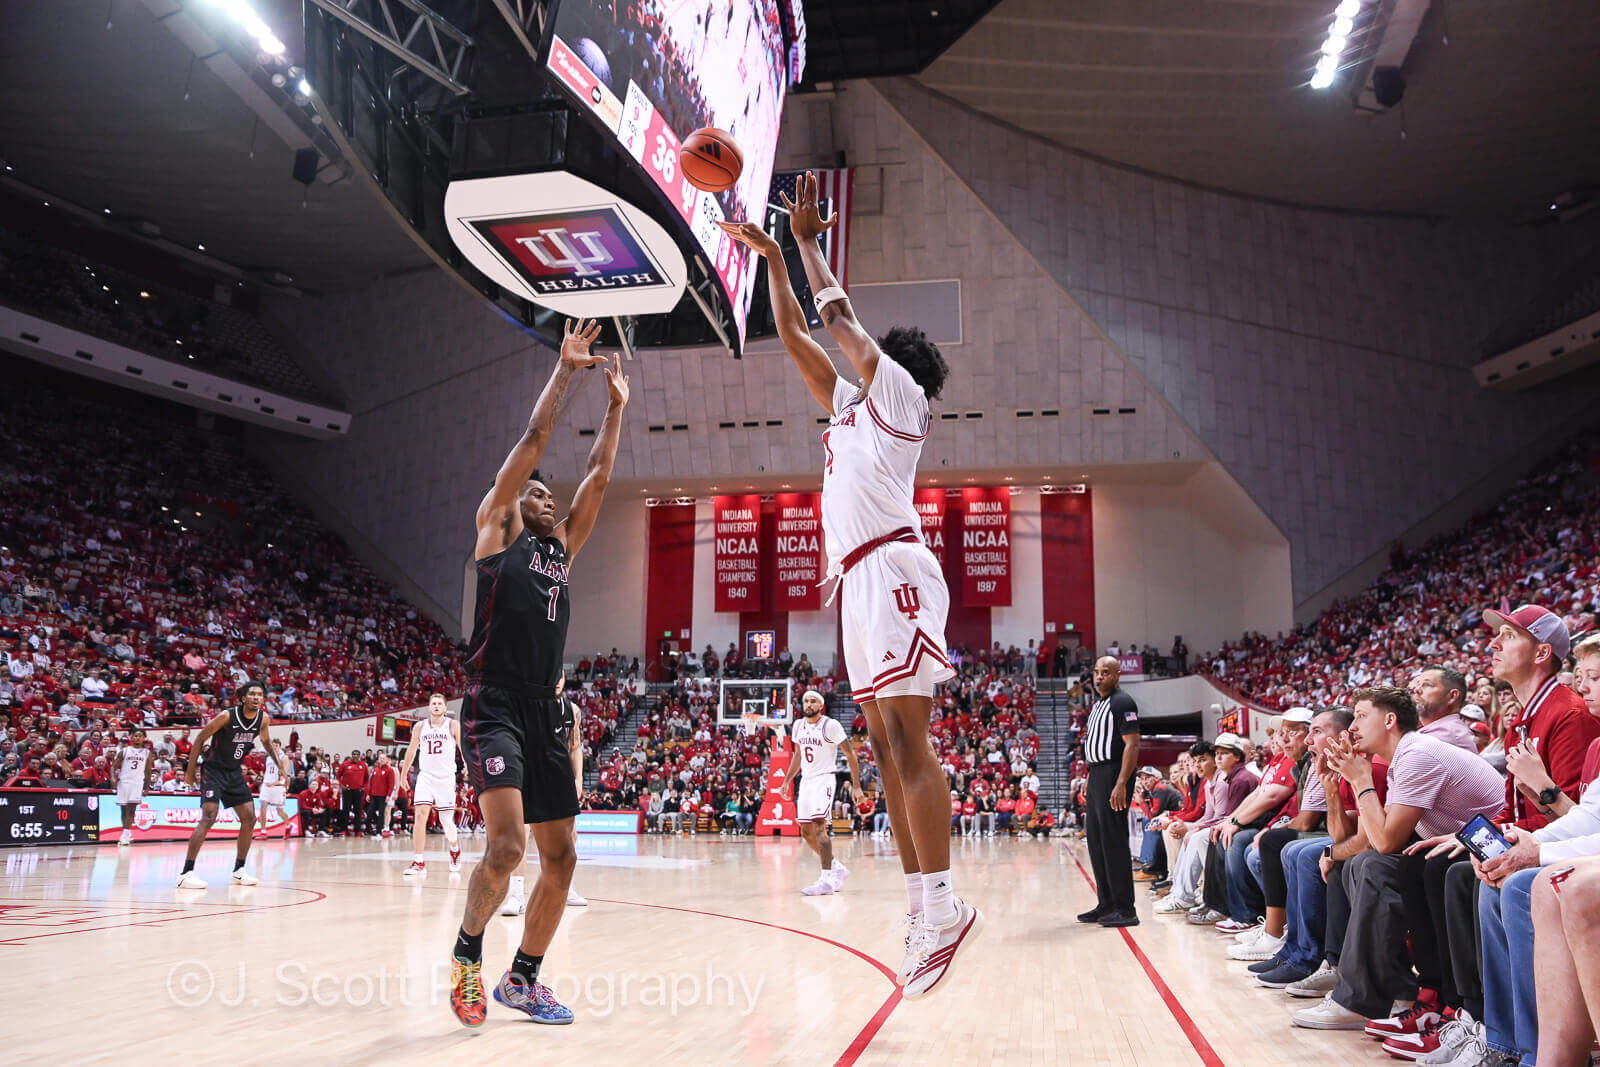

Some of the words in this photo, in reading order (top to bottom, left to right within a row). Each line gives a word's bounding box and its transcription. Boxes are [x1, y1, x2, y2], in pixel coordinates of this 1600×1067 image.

[652, 134, 677, 184] 36
[537, 272, 654, 291] HEALTH
[783, 507, 814, 519] INDIANA
[969, 501, 1003, 513] INDIANA
[722, 509, 753, 520] INDIANA
[964, 514, 1007, 526] UNIVERSITY
[717, 522, 758, 533] UNIVERSITY
[778, 520, 818, 532] UNIVERSITY
[920, 516, 943, 527] RSITY
[776, 536, 819, 553] NCAA
[925, 531, 944, 547] AA
[963, 530, 1009, 548] NCAA
[716, 537, 759, 554] NCAA
[778, 556, 817, 568] BASKETBALL
[964, 551, 1008, 563] BASKETBALL
[529, 551, 568, 585] AAM
[717, 558, 757, 570] BASKETBALL
[966, 564, 1007, 576] CHAMPIONS
[718, 571, 756, 583] CHAMPIONS
[779, 569, 816, 582] CHAMPIONS
[728, 587, 747, 598] 1940
[788, 585, 807, 597] 1953
[976, 580, 997, 593] 1987
[547, 585, 560, 621] 1
[892, 583, 921, 620] IU
[756, 643, 770, 657] 18
[422, 733, 448, 741] INDIANA
[233, 743, 245, 760] 5
[427, 740, 443, 755] 12
[804, 746, 814, 763] 6
[130, 760, 139, 770] 3
[19, 805, 35, 815] 1ST
[57, 809, 69, 821] 10
[10, 822, 43, 839] 6:55
